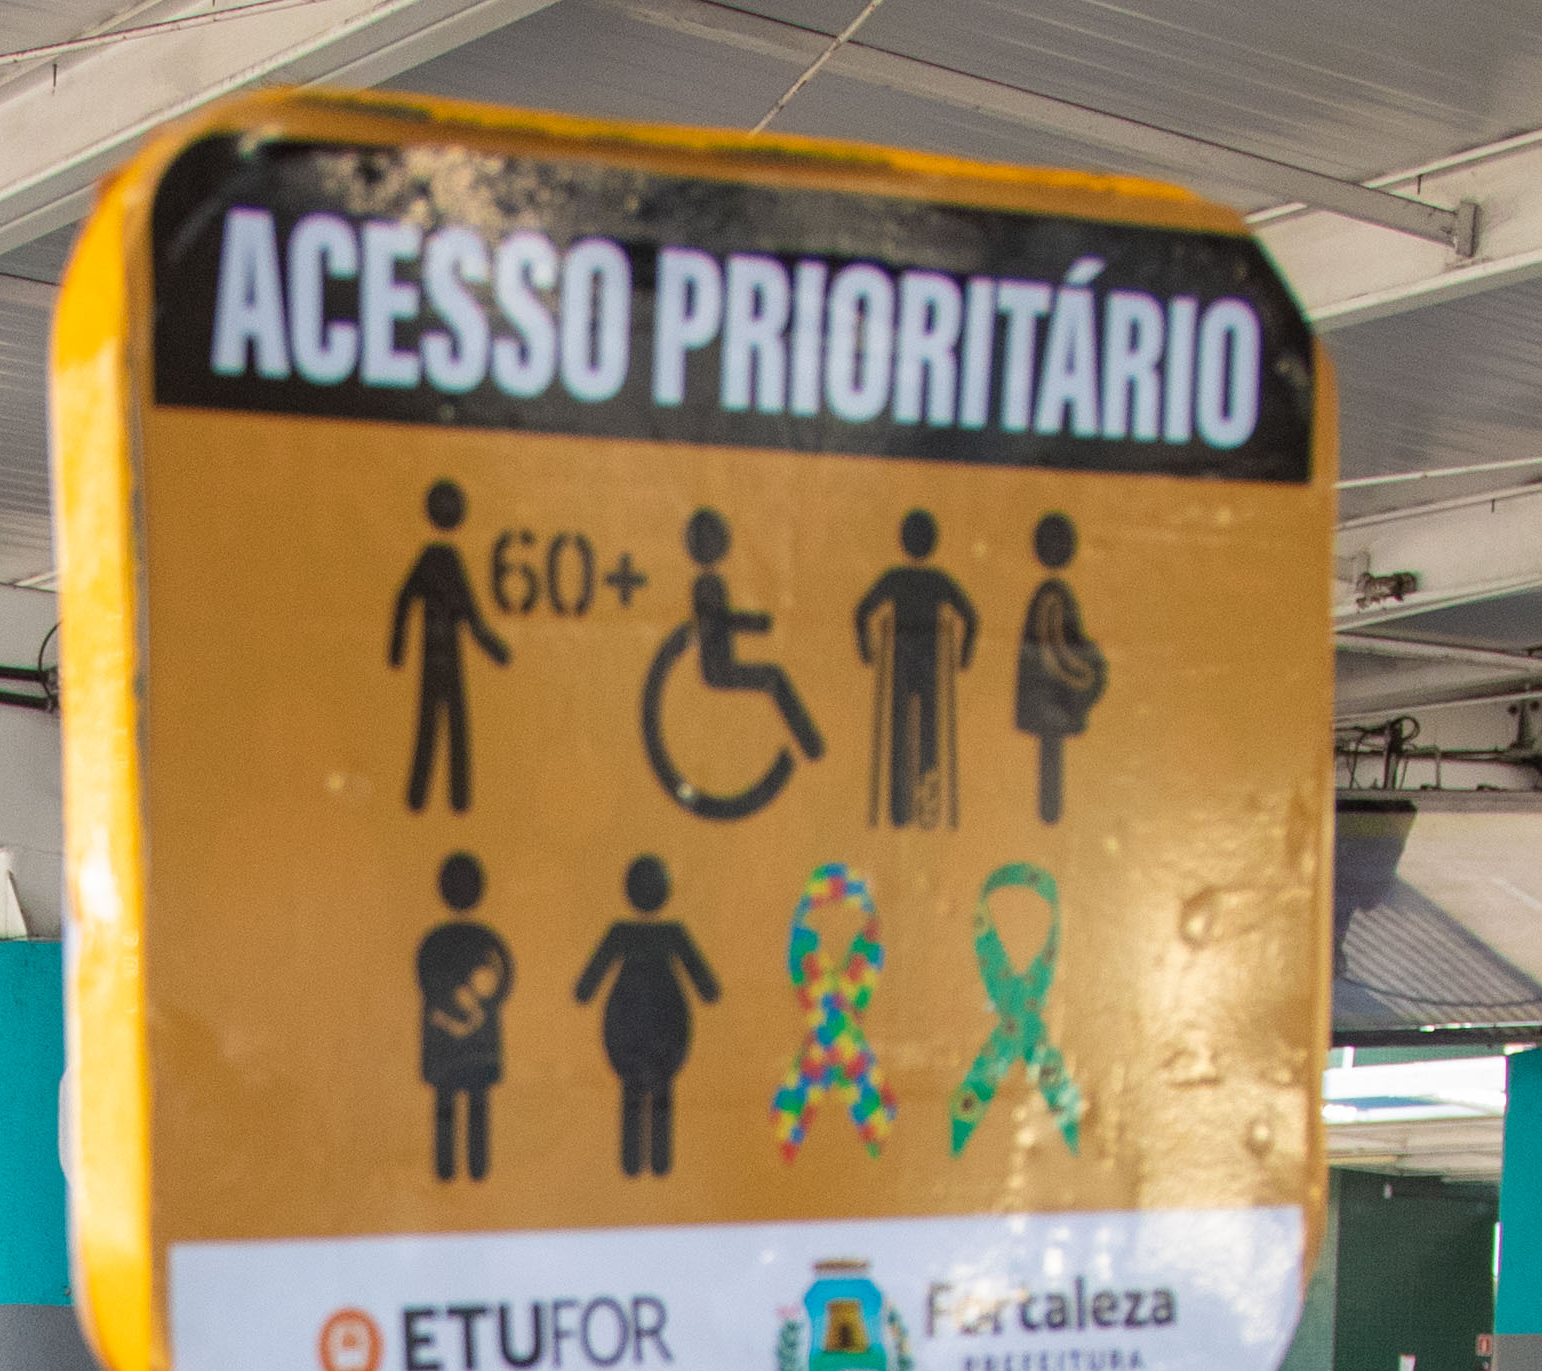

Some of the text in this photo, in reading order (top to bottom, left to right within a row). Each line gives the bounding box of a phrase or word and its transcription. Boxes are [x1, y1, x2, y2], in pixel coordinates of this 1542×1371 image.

[209, 209, 1263, 452] ACESSO PRIORITÁRIO
[490, 528, 648, 620] 60+
[924, 1281, 1179, 1338] Fortaleza
